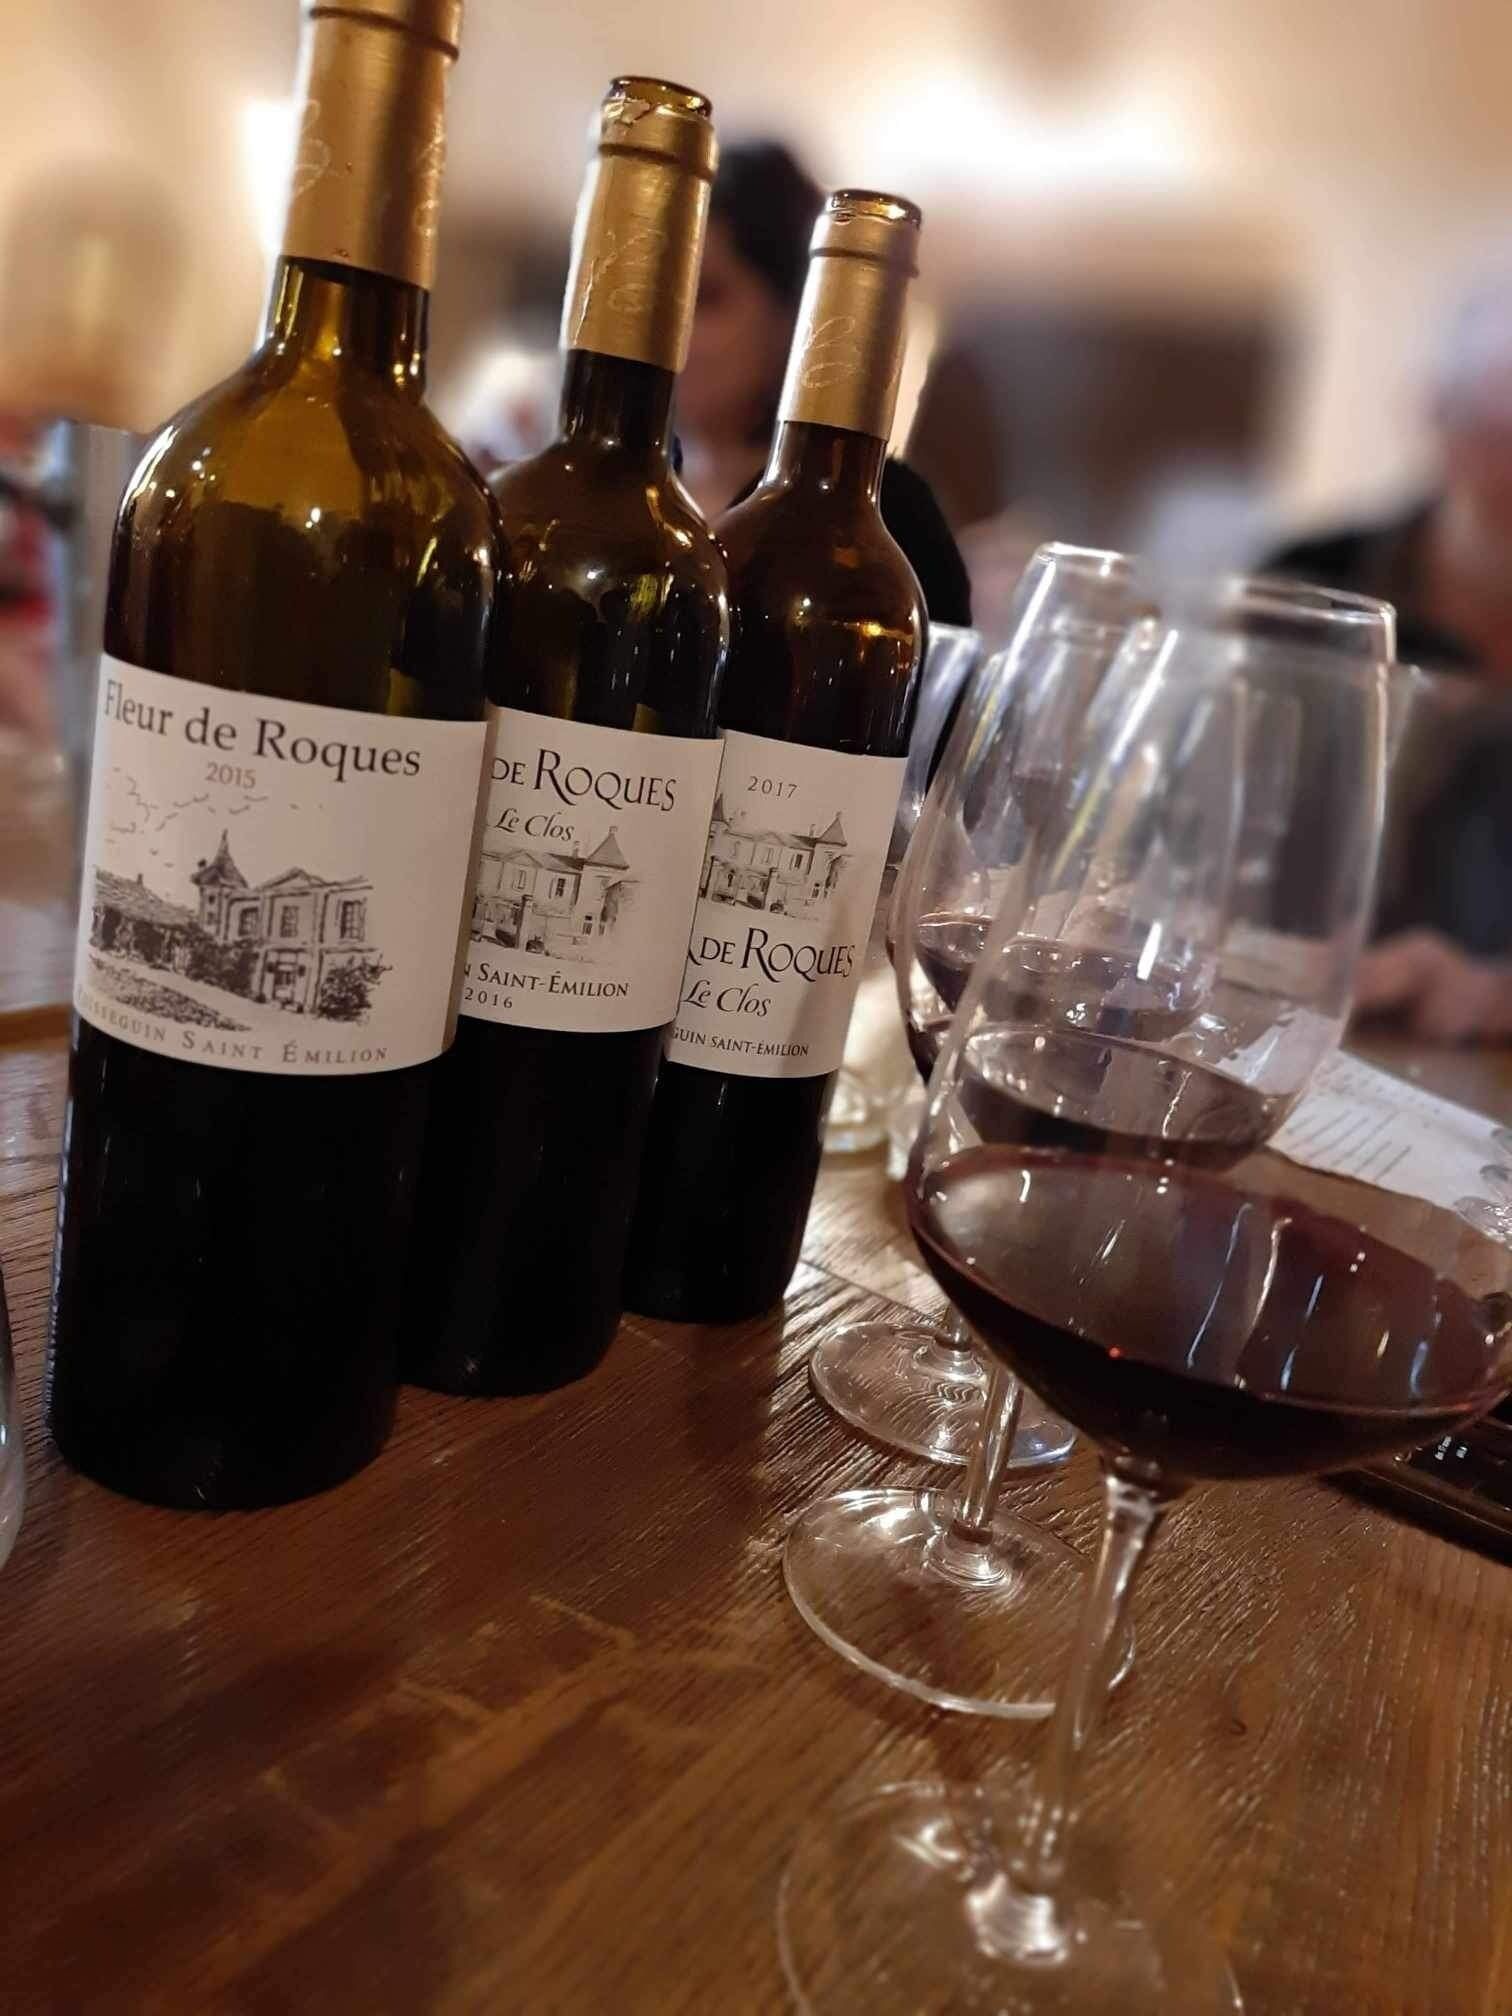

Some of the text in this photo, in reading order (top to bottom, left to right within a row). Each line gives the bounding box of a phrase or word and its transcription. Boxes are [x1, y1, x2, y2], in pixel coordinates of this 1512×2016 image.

[104, 679, 421, 783] Fleur de Roques
[205, 761, 256, 790] 2015
[534, 748, 676, 812] ROQUES
[747, 776, 798, 799] 2017
[494, 808, 575, 841] Le Clos
[701, 936, 736, 965] DE
[741, 927, 855, 983] ROQUES
[464, 987, 513, 1010] 2016
[684, 979, 771, 1018] Le Clos
[182, 1029, 264, 1061] SAINT
